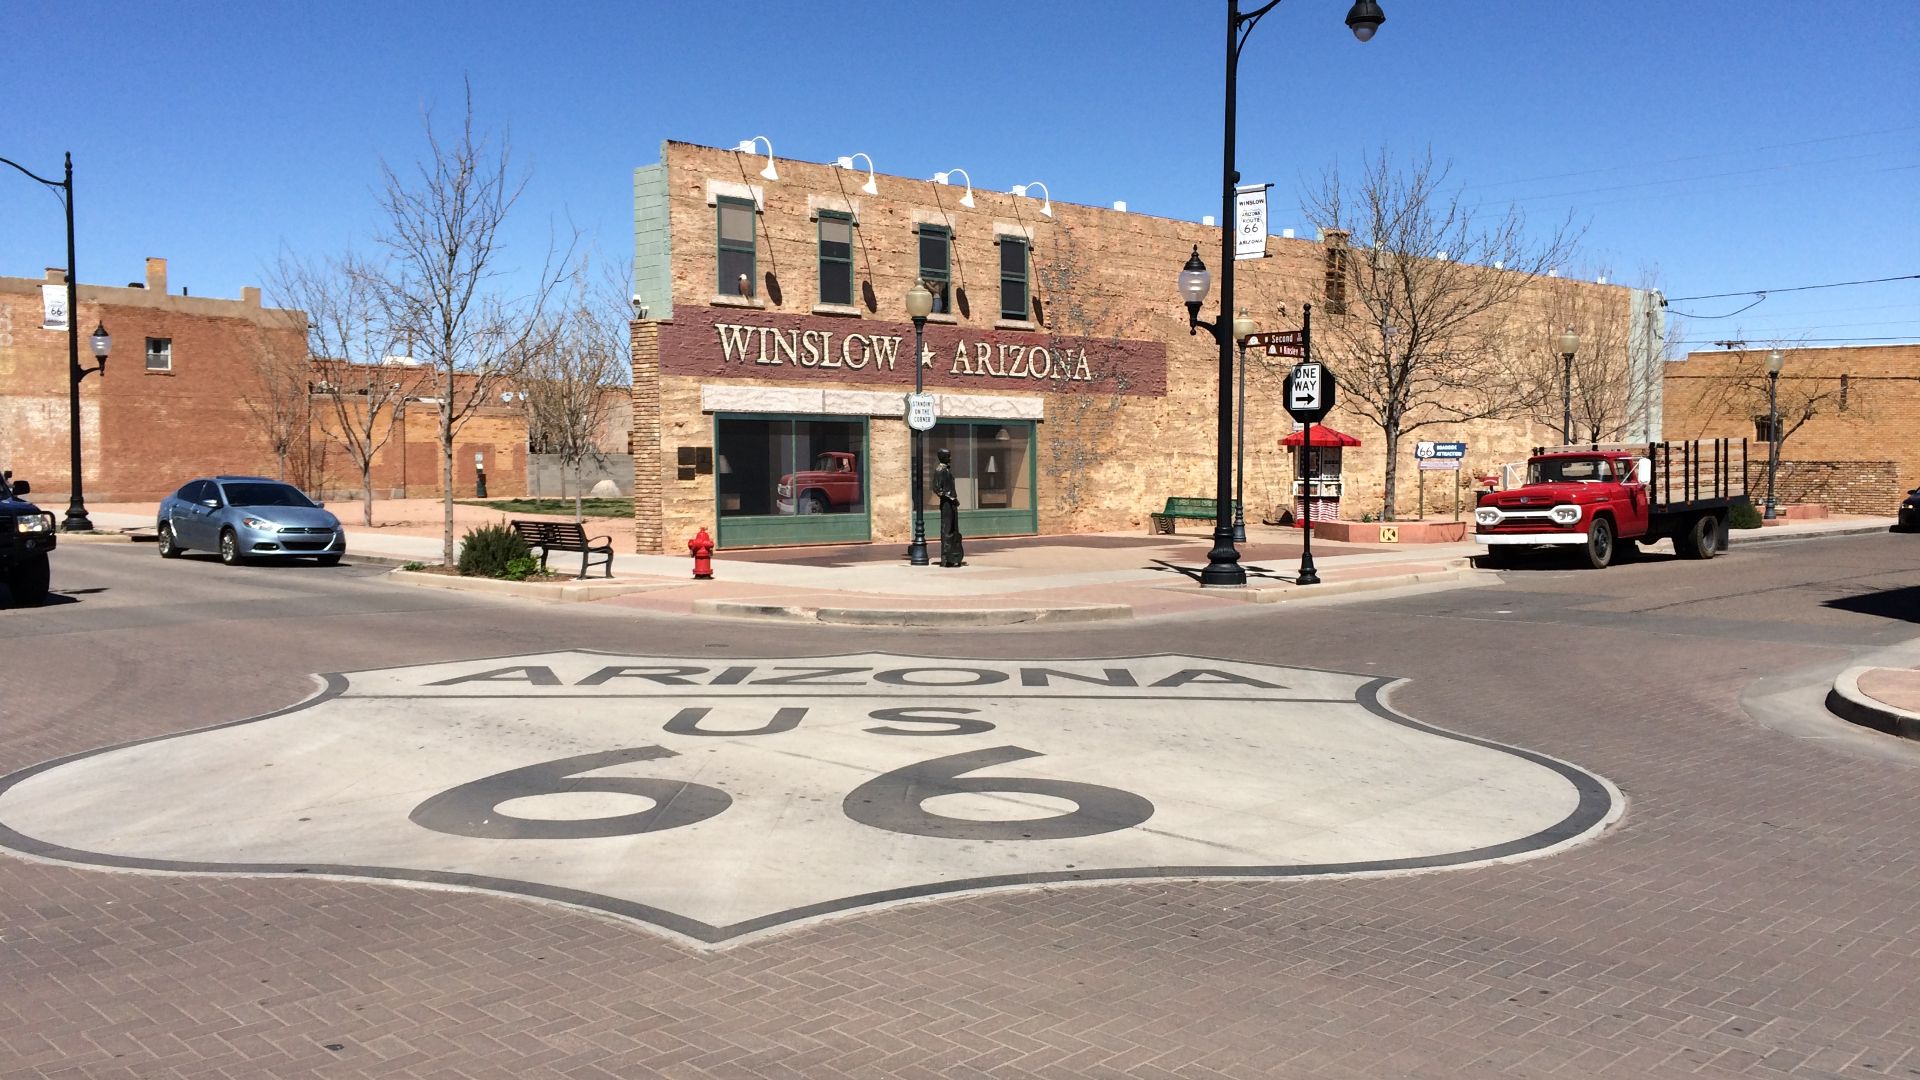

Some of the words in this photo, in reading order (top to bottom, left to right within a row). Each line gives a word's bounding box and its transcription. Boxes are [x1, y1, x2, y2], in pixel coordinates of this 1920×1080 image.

[1244, 223, 1259, 234] 66
[51, 308, 62, 316] 66
[1272, 334, 1293, 343] Second
[714, 323, 903, 371] WINSLOW
[949, 339, 1093, 381] ARIZONA
[1295, 368, 1316, 379] ONE
[1294, 380, 1317, 391] WAY
[1419, 447, 1433, 456] 66
[418, 665, 1292, 690] ARIZONA
[408, 744, 1155, 841] 66
